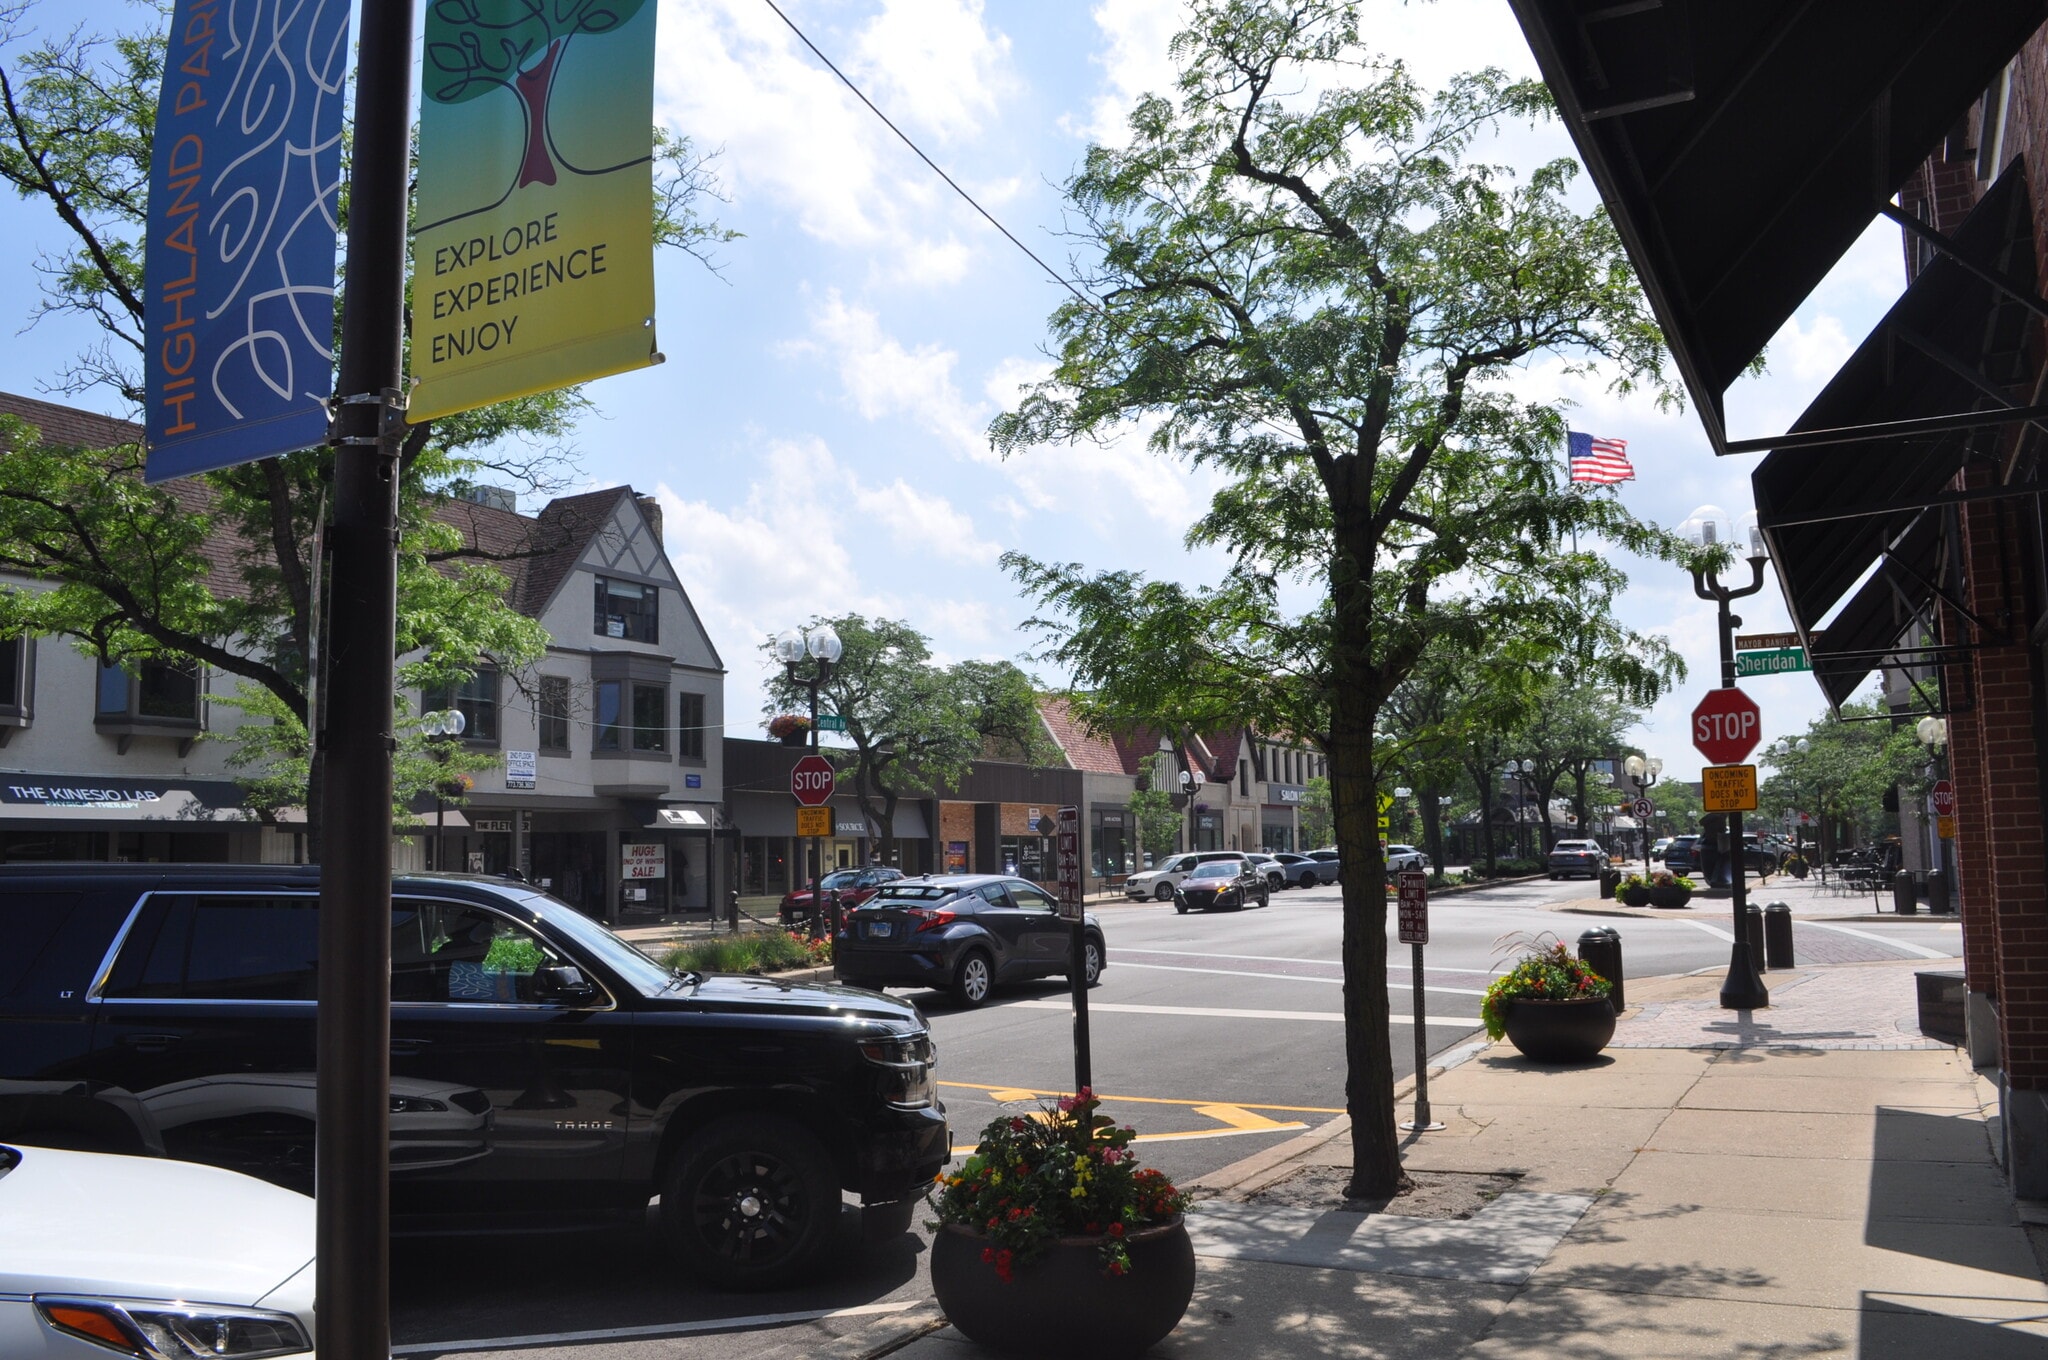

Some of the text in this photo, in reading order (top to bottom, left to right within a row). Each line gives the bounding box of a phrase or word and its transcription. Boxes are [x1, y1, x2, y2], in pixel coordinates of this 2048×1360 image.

[435, 212, 558, 276] EXPLORE
[162, 134, 203, 436] HIGHLAND
[433, 243, 607, 320] EXPERIENCE
[432, 315, 519, 364] ENJOY
[1738, 639, 1762, 649] MAYOR
[1766, 637, 1790, 647] DANIEL
[1737, 653, 1796, 672] Sheridan
[1697, 711, 1756, 742] STOP
[1708, 769, 1749, 779] ONCOMING
[794, 771, 831, 790] STOP
[1713, 779, 1745, 788] TRAFFIC
[9, 786, 160, 802] THE KINESIO LAB
[1281, 789, 1299, 801] SALON
[1710, 788, 1749, 799] DOES NOT
[45, 800, 140, 809] PHYSICAL THERAPY
[1720, 799, 1740, 808] STOP
[477, 821, 489, 830] THE
[631, 845, 656, 857] HUGE
[645, 857, 665, 865] WINTER
[631, 866, 656, 878] SALE!
[1399, 874, 1425, 889] 15 MINUTE
[1404, 889, 1420, 899] LIMIT
[1400, 899, 1425, 910] 8AM-7PM
[1399, 909, 1426, 920] MON-SAT
[1400, 920, 1405, 930] 2
[1405, 920, 1414, 931] HR
[60, 990, 74, 998] LT
[554, 1120, 612, 1129] TAHOE
